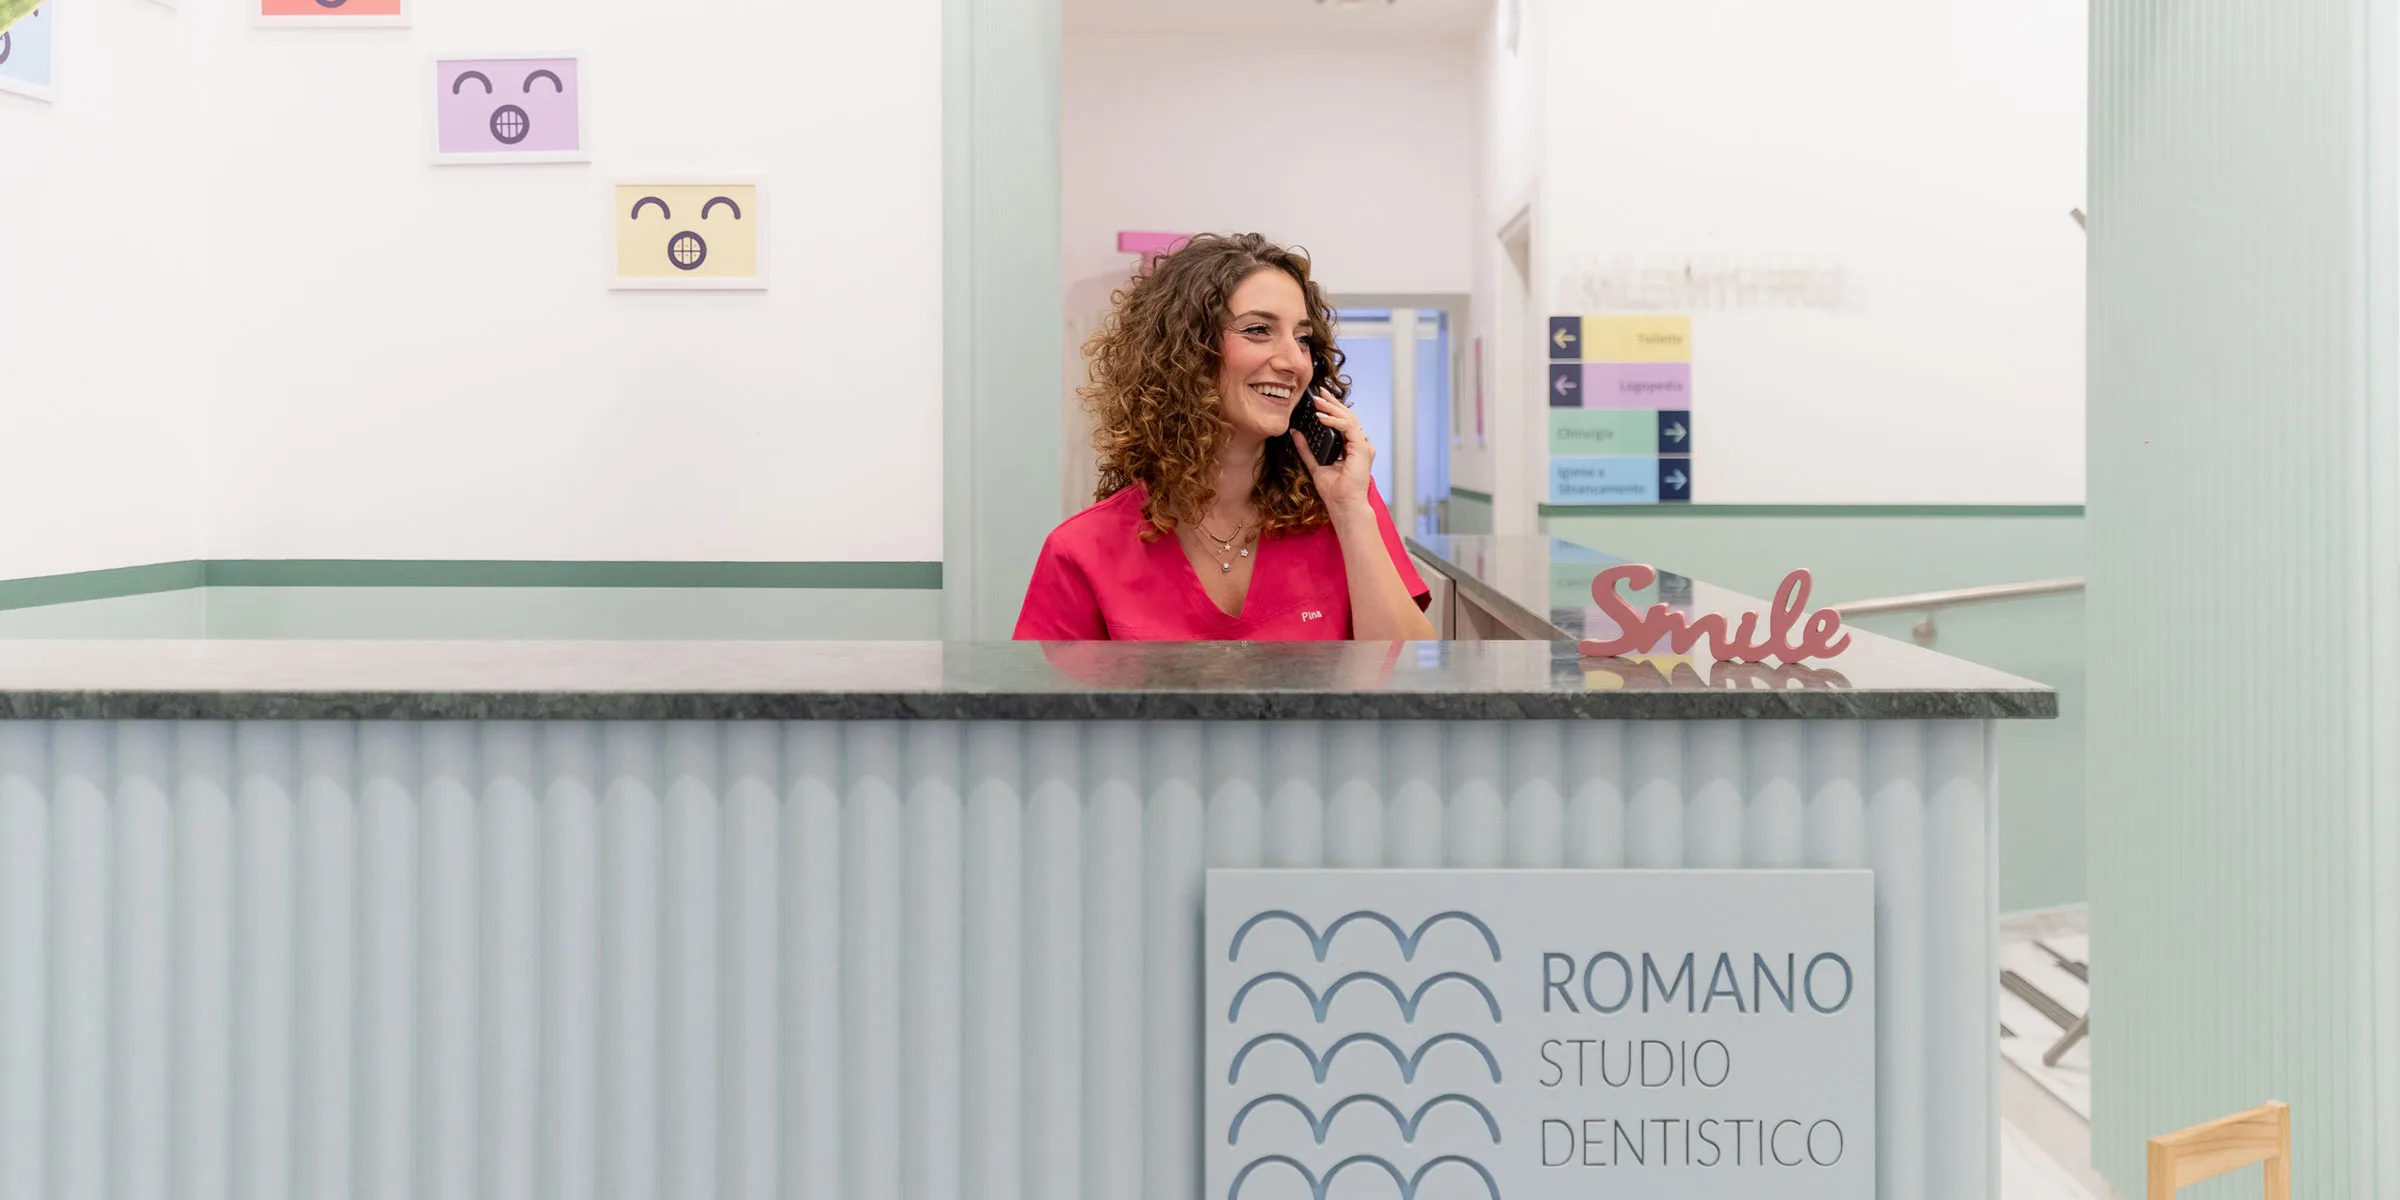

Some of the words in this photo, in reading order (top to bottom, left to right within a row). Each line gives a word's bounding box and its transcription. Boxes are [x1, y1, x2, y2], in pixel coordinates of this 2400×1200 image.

[1619, 379, 1683, 395] Logopedia
[1557, 427, 1614, 442] Chirurgia
[1301, 610, 1323, 622] Pina
[1578, 563, 1852, 664] Smile
[1541, 951, 1854, 1015] ROMANO
[1539, 1039, 1731, 1088] STUDIO
[1541, 1118, 1844, 1168] DENTISTICO
